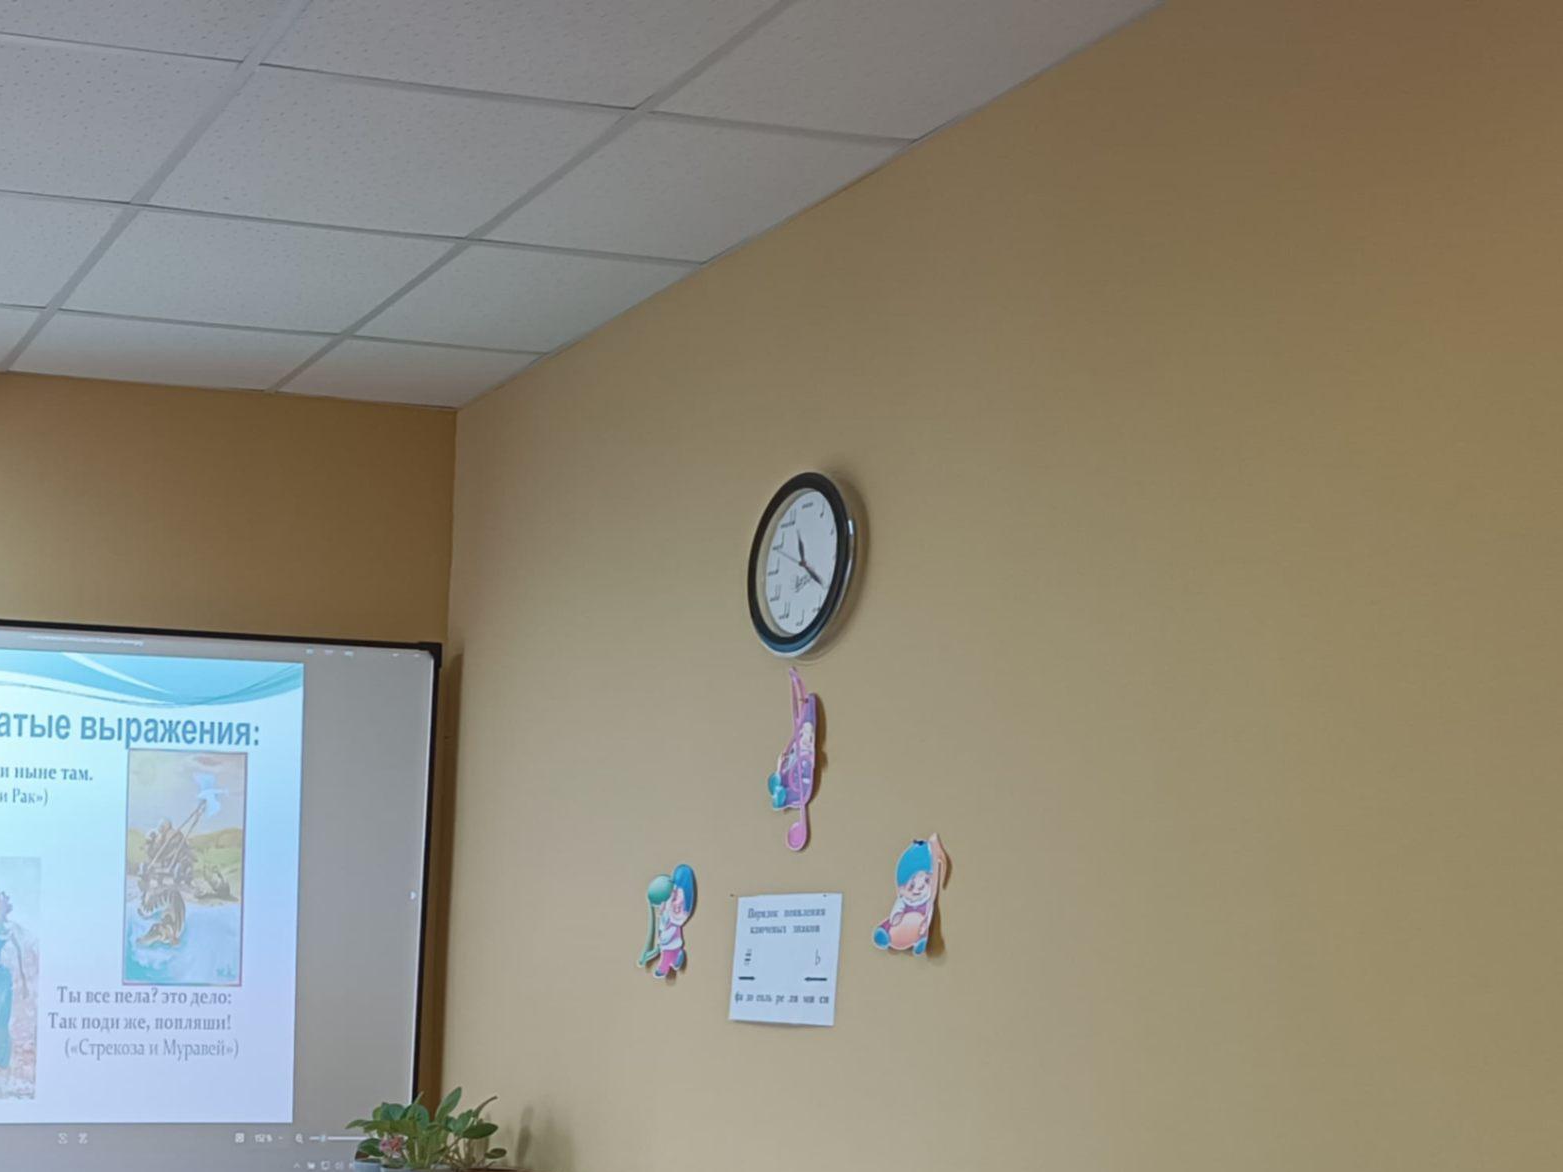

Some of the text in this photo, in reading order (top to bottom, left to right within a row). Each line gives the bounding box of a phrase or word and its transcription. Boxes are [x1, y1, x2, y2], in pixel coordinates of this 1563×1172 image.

[80, 711, 260, 748] выражения:
[0, 767, 10, 779] и
[14, 767, 57, 781] ныне
[61, 768, 94, 782] там.
[0, 793, 8, 804] и
[12, 788, 49, 807] Рак»)
[57, 986, 232, 1007] Ты все пела? это дело:
[48, 1012, 232, 1032] Так поди же, попляши!
[64, 1037, 238, 1062] («Стрекоза и Муравей»)
